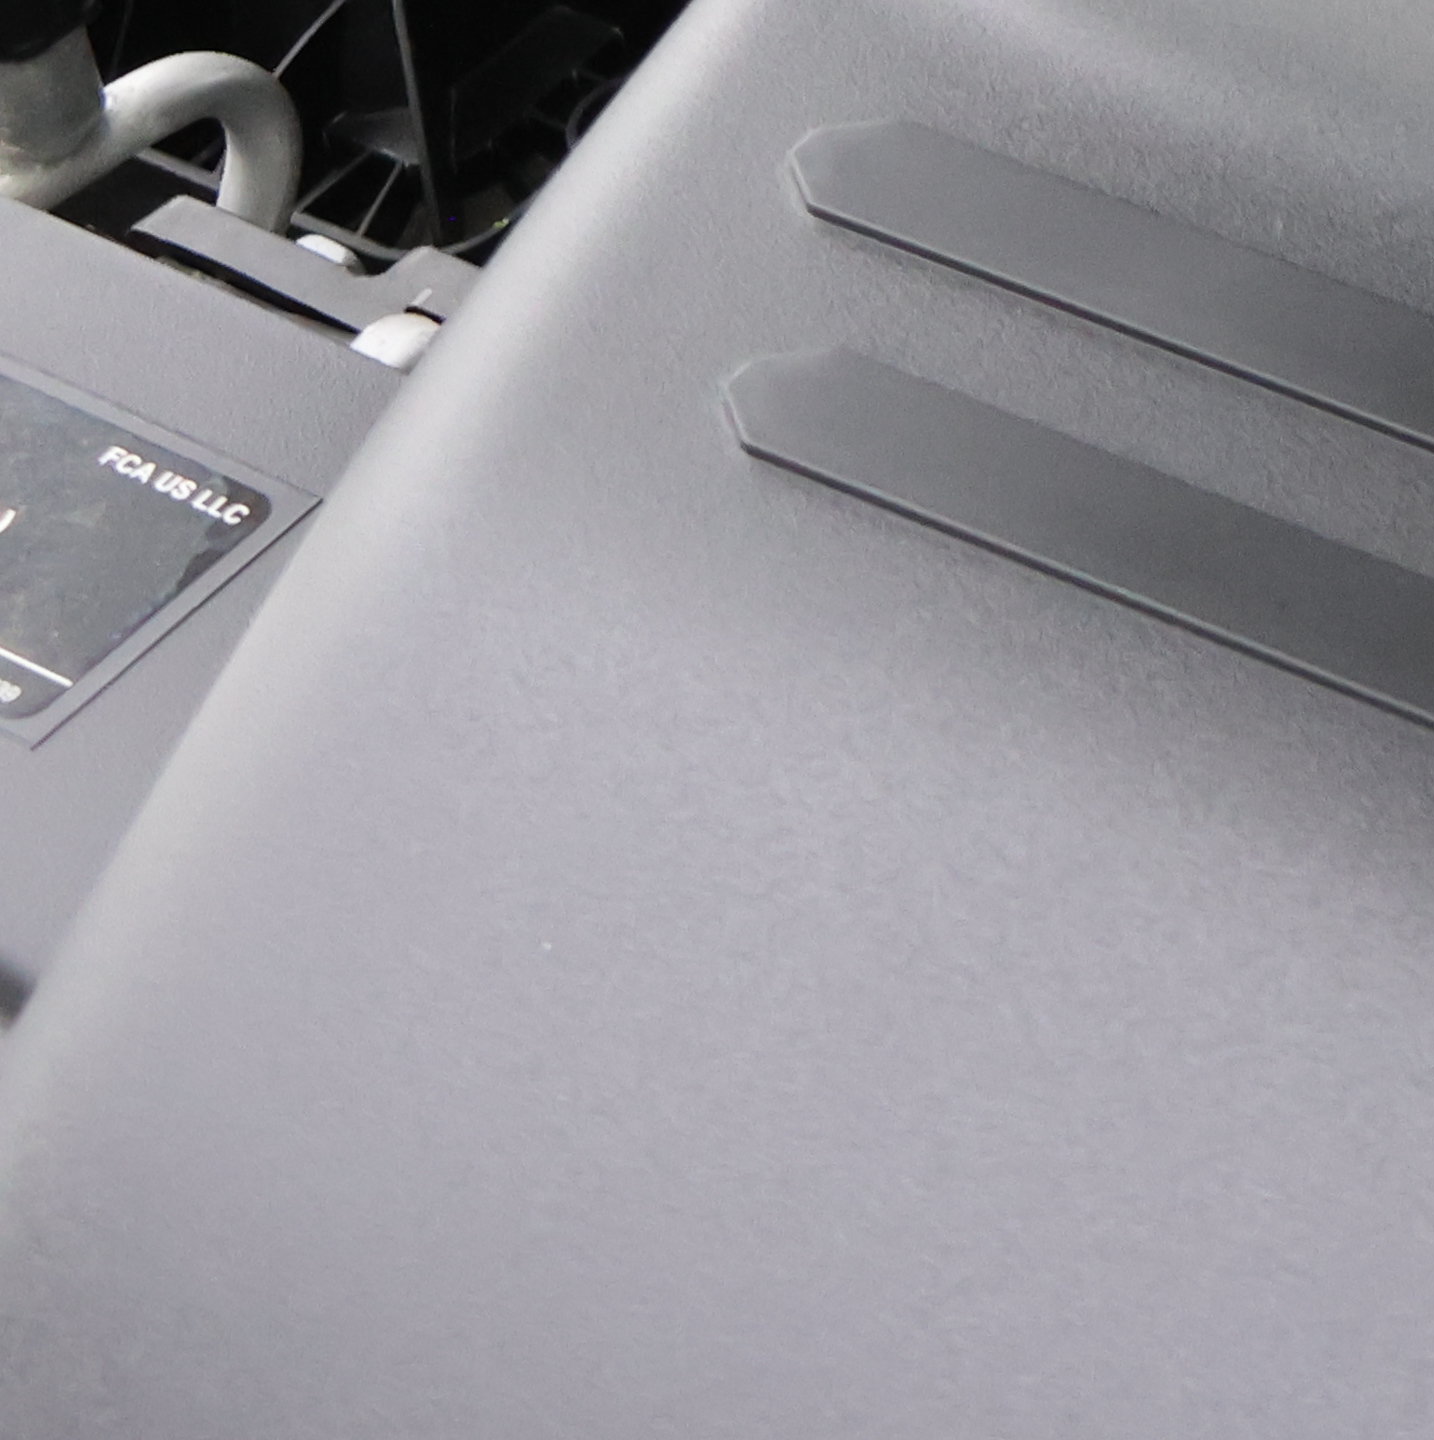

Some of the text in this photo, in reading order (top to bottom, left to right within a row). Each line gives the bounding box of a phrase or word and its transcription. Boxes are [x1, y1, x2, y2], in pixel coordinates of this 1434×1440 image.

[98, 445, 251, 526] FCA US LLC
